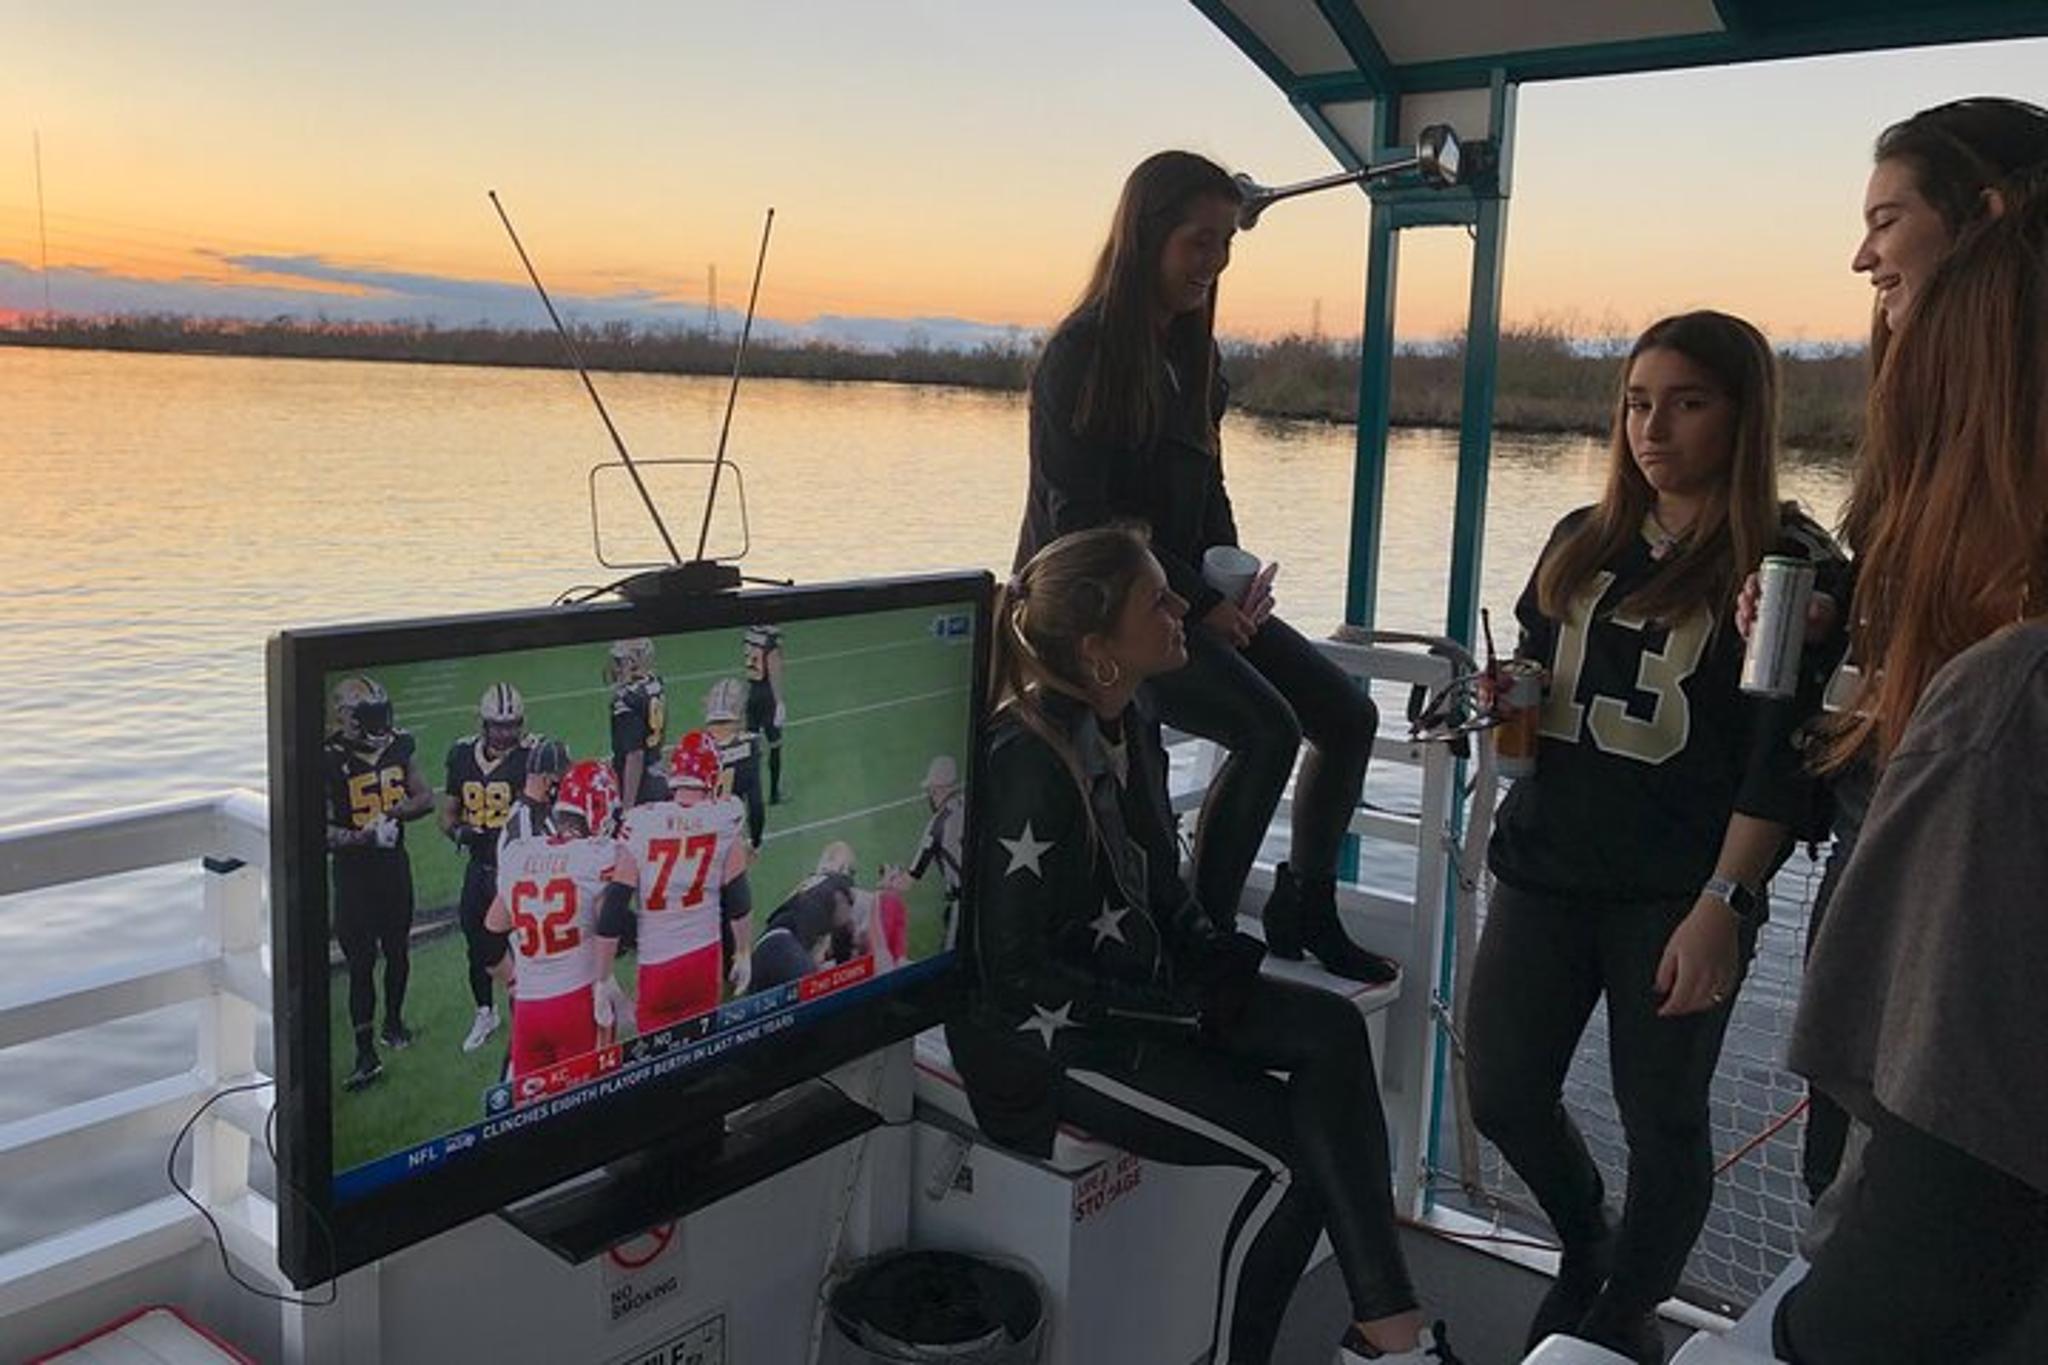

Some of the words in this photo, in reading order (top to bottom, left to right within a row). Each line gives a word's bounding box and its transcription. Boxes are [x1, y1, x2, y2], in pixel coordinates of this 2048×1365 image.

[1537, 569, 1714, 765] 13
[348, 765, 406, 829] 56
[645, 832, 718, 911] 77
[511, 877, 582, 957] 62
[599, 1051, 616, 1071] 14
[653, 1031, 672, 1049] NO
[700, 1017, 709, 1034] 7
[408, 1147, 438, 1168] NFL
[482, 1104, 550, 1140] CLINCHES
[551, 1089, 597, 1114] EIGHTH
[600, 1066, 651, 1097] PLAYOFF
[653, 1048, 692, 1078] BERTH
[693, 1045, 704, 1061] IN
[707, 1035, 733, 1057] LAST
[736, 1025, 760, 1046] NINE
[611, 1284, 633, 1304] NO
[611, 1276, 678, 1320] SMOKING
